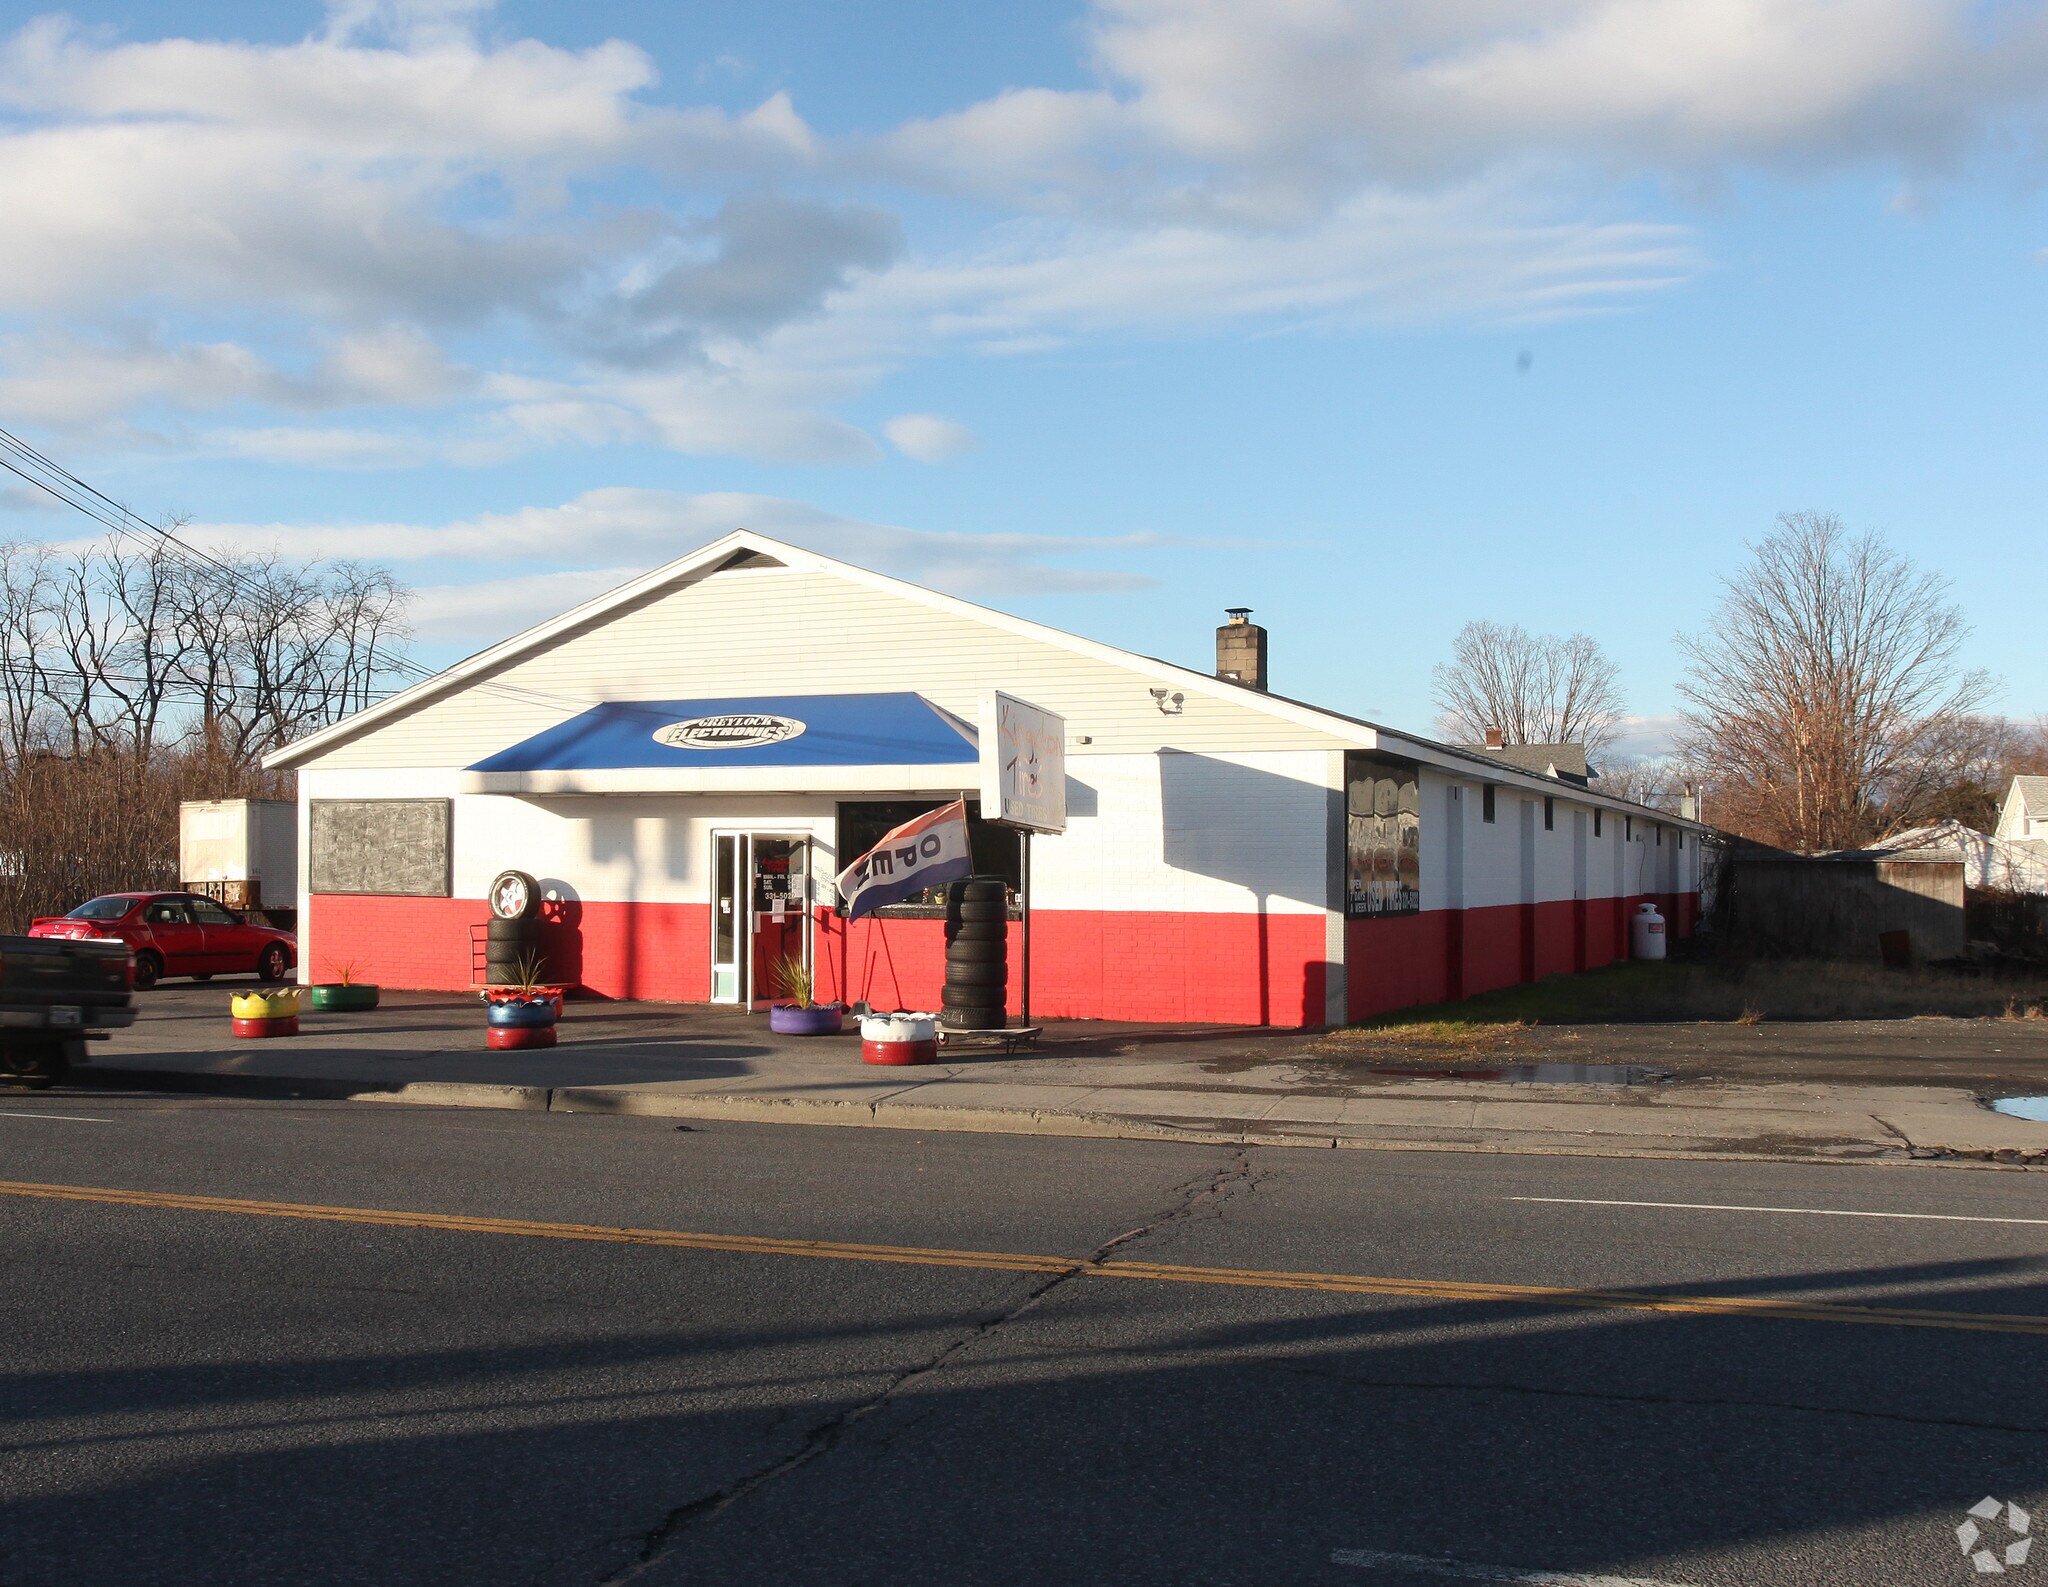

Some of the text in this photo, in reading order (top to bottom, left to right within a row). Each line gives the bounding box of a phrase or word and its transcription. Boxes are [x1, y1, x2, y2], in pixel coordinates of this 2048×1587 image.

[667, 725, 789, 743] ELECTRONICS
[853, 834, 941, 891] OPEN
[1367, 880, 1402, 912] USED TIRES
